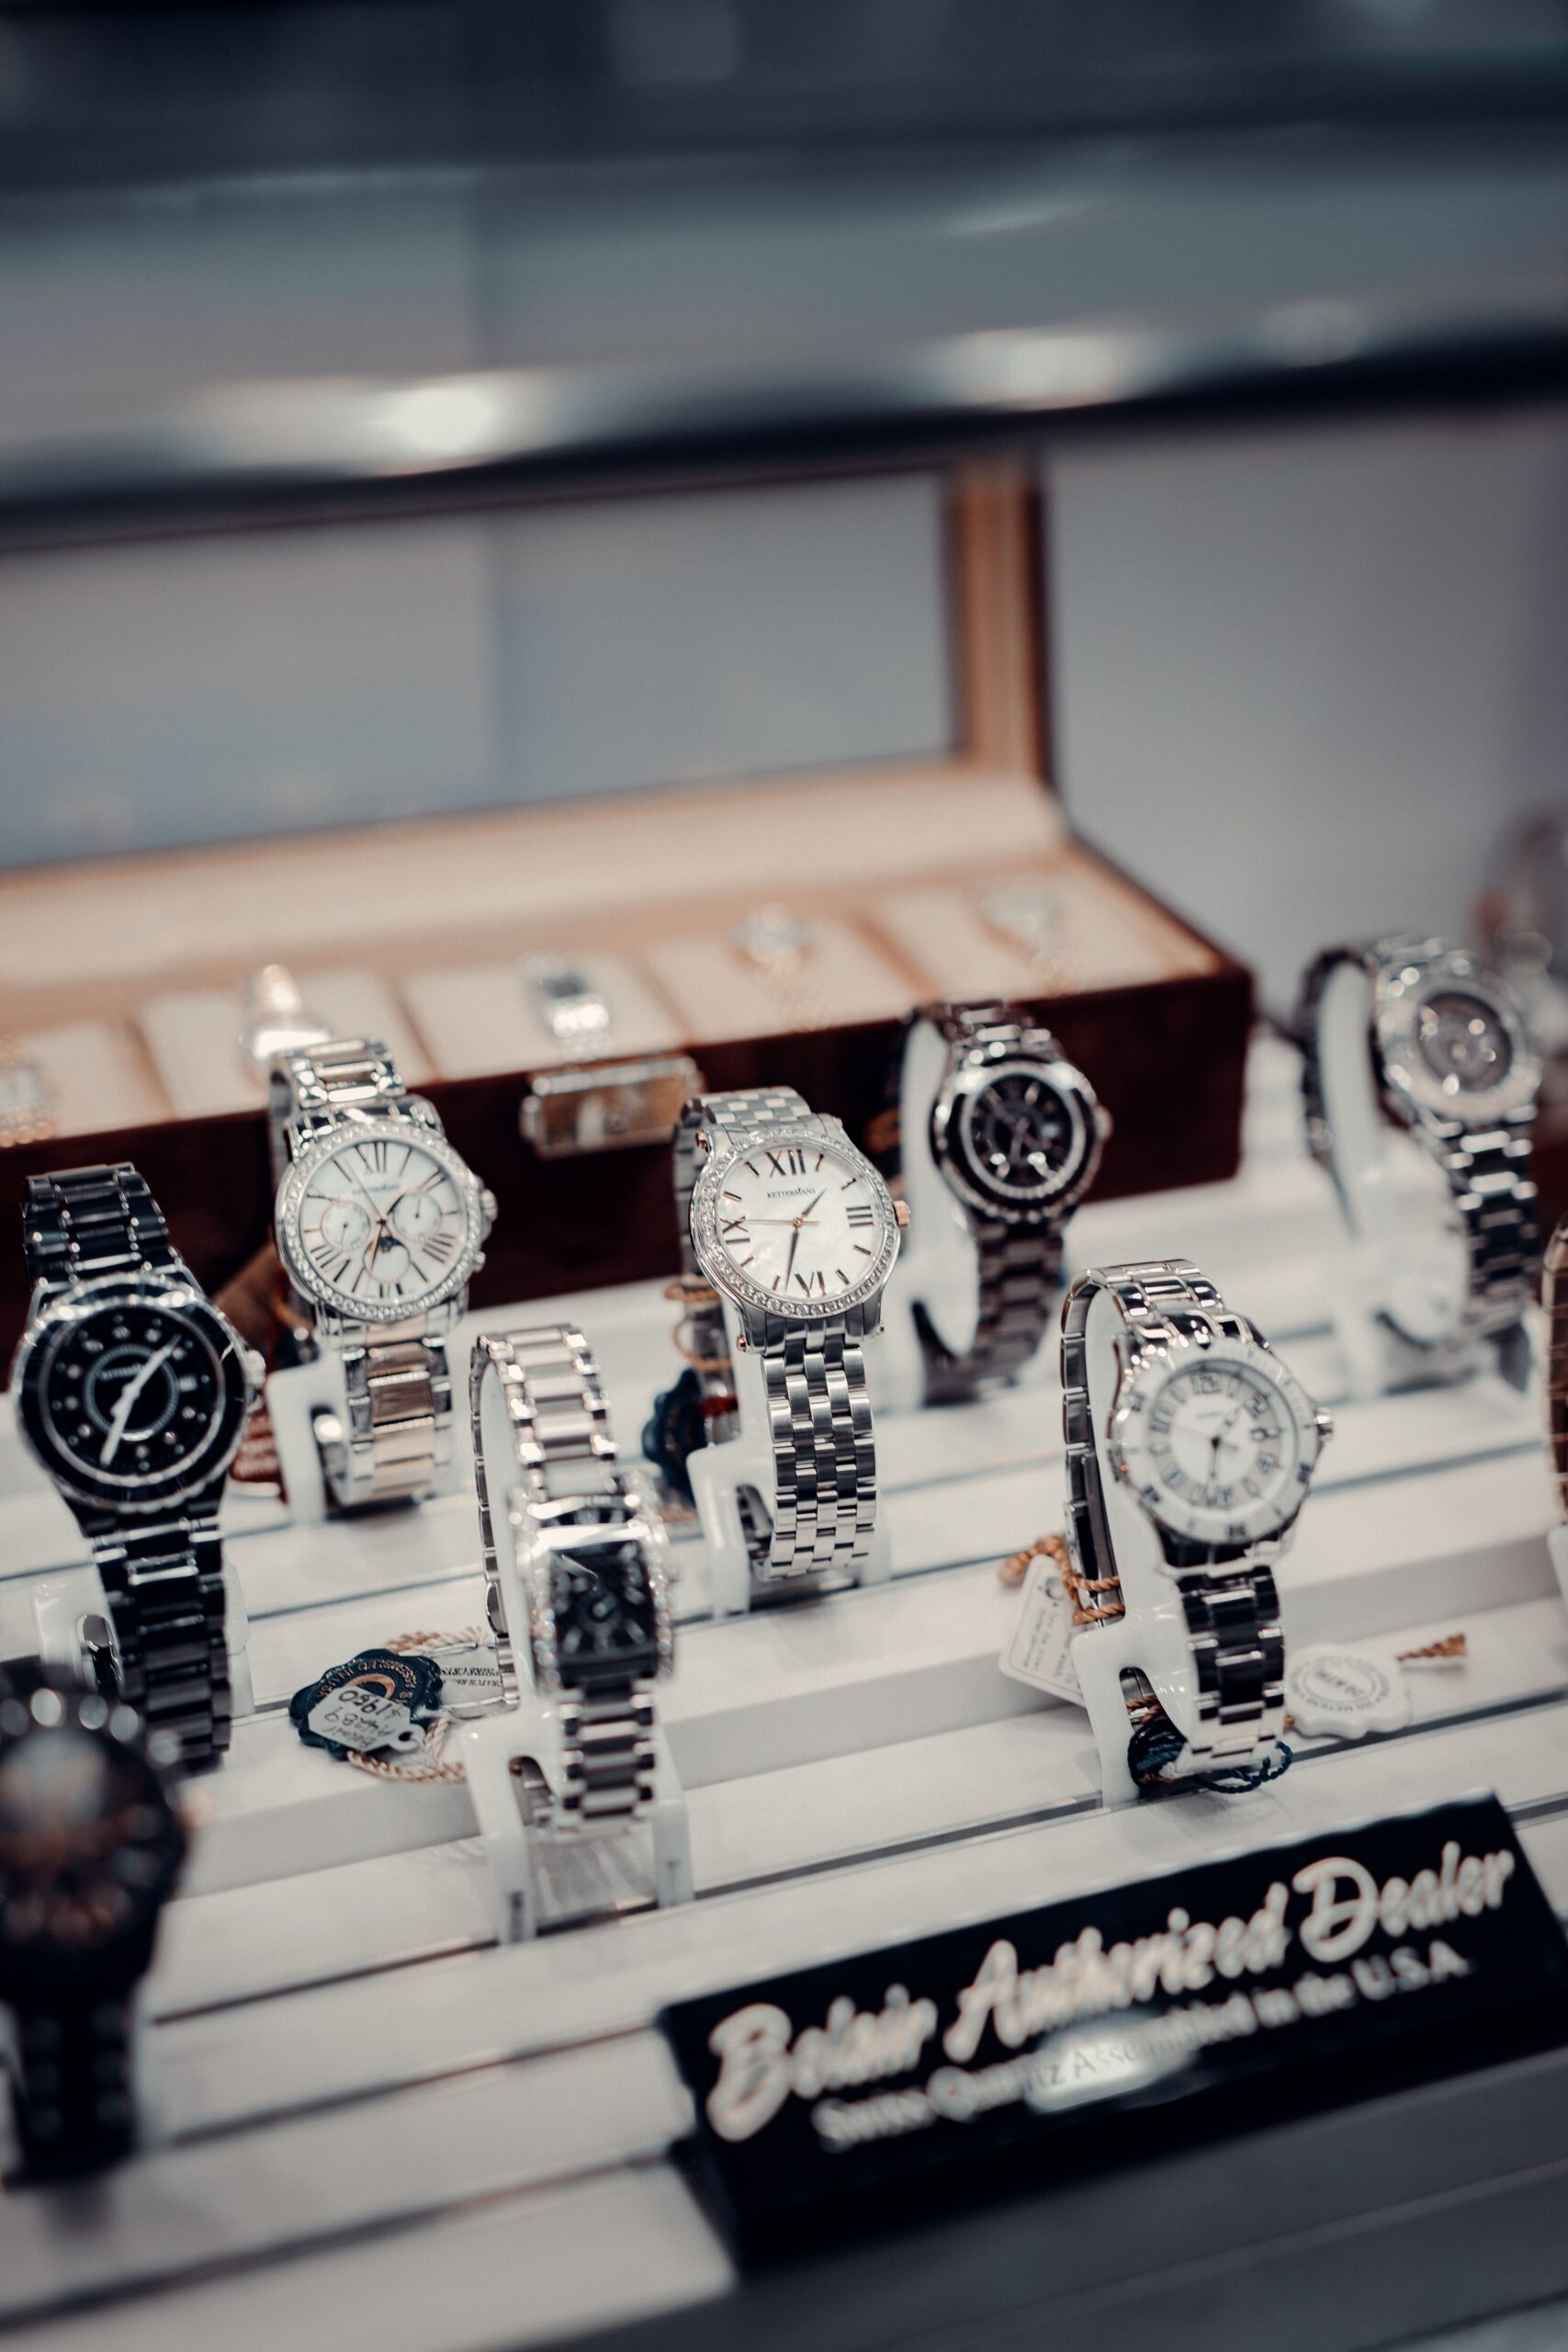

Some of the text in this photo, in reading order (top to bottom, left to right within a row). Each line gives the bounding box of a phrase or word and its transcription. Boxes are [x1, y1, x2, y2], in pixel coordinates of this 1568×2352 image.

[765, 1148, 806, 1179] XII
[942, 1881, 1292, 2063] Authorized
[1292, 1840, 1515, 1963] Dealer
